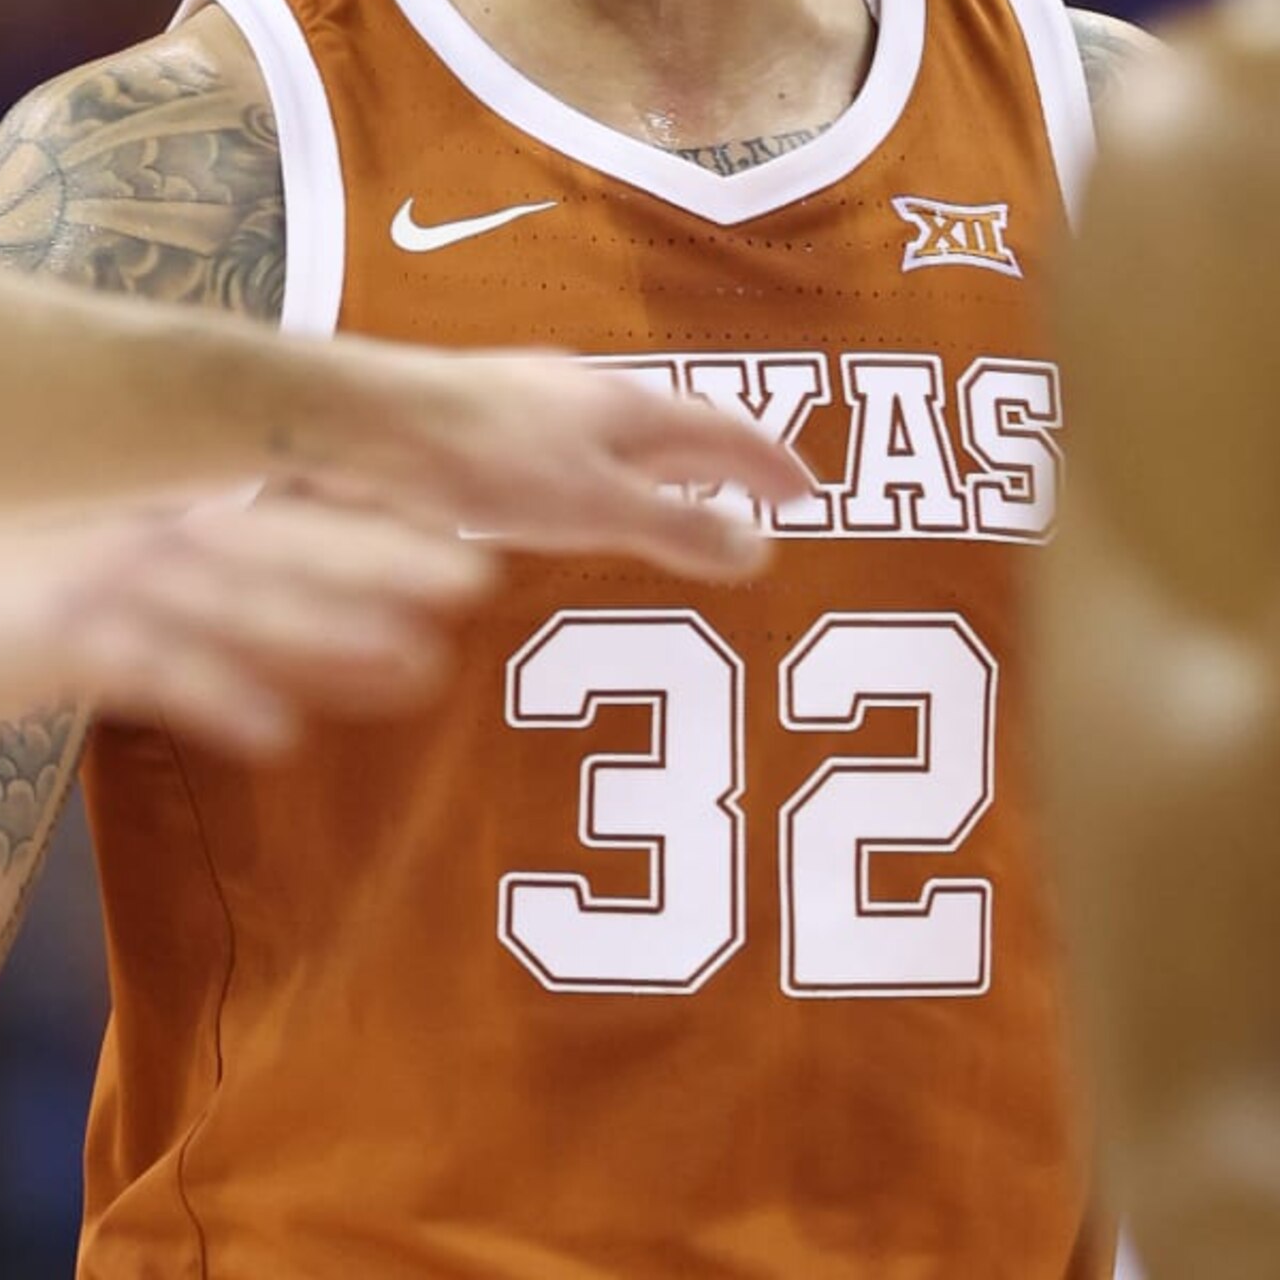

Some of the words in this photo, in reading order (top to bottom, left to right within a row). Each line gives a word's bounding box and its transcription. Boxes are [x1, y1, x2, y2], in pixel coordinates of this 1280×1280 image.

[897, 198, 1018, 273] XII
[458, 351, 1064, 545] XAS
[497, 607, 999, 999] 32
